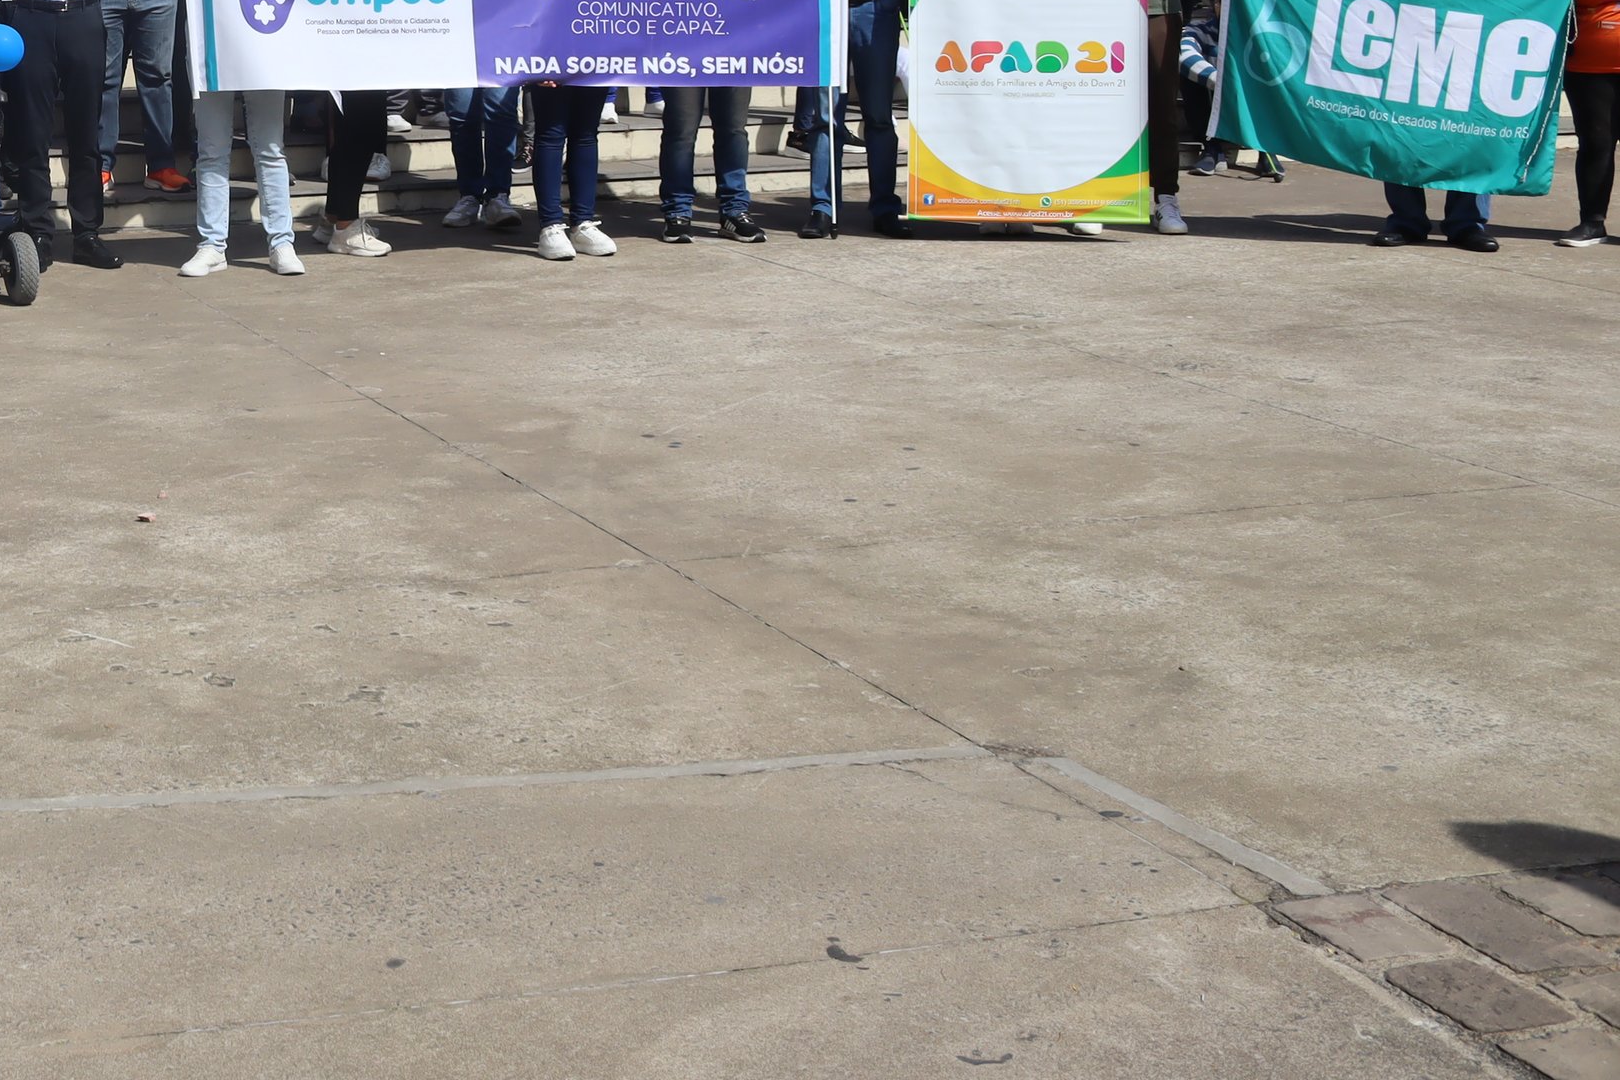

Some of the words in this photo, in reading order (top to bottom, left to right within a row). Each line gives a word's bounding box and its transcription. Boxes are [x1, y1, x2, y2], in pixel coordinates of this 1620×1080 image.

[577, 1, 722, 18] COMUNICATIVO,
[336, 18, 365, 26] Municipal
[356, 27, 390, 35] Deficiência
[418, 27, 450, 35] Hamburgo
[570, 15, 640, 35] CRÍTICO
[646, 20, 656, 35] E
[662, 20, 729, 35] CAPAZ.
[494, 56, 561, 75] NADA
[566, 56, 637, 75] SOBRE
[642, 52, 696, 77] NÓS,
[702, 56, 755, 75] SEM
[758, 52, 804, 75] NÓS!
[935, 40, 1070, 73] AFAD
[1075, 40, 1125, 73] 21
[935, 78, 979, 88] Associação
[980, 78, 994, 87] dos
[996, 78, 1036, 87] Familiares
[1045, 78, 1076, 90] Amigos
[1078, 78, 1089, 87] do
[1091, 78, 1115, 87] Down
[1117, 78, 1126, 87] 21
[1306, 95, 1367, 118] Associação
[1368, 108, 1389, 122] dos
[1391, 110, 1437, 130] Lesados
[1440, 119, 1497, 138] Medulares
[1499, 125, 1512, 138] do
[1514, 125, 1530, 139] RS
